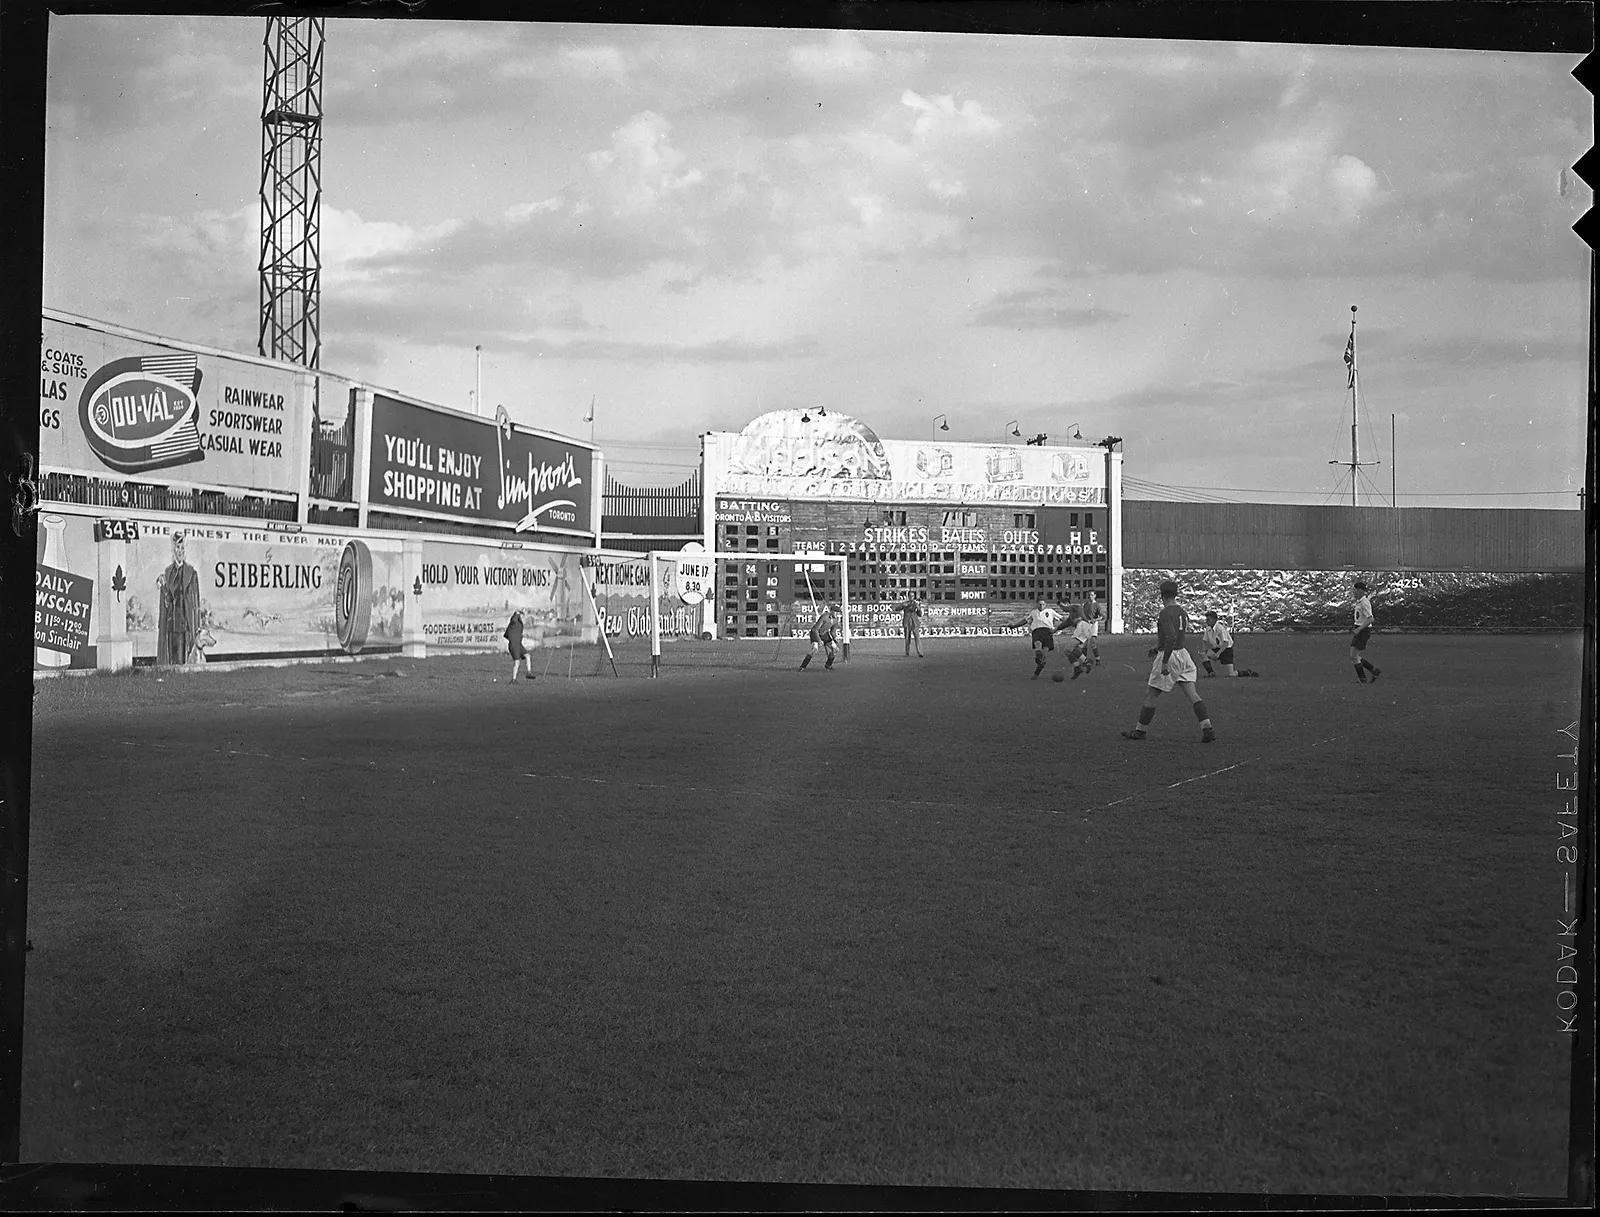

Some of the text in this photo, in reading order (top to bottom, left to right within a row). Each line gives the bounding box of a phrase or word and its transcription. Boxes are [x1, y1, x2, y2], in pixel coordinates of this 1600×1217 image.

[46, 349, 83, 366] COATS
[42, 360, 87, 379] & SUITS
[41, 379, 67, 401] LAS
[224, 387, 284, 411] RAINWEAR
[41, 409, 60, 430] GS
[210, 410, 283, 435] SPORTSWEAR
[200, 433, 282, 458] CASUAL WEAR
[385, 434, 481, 479] YOU'LL ENJOY
[498, 408, 582, 530] Simpson's
[383, 470, 483, 510] SHOPPING AT
[720, 501, 780, 511] BATTING
[548, 510, 576, 523] TORONTO
[762, 514, 792, 523] VISITORS
[143, 526, 344, 547] THE FINEST TIRE EVER MADE
[770, 527, 776, 536] 5
[864, 528, 1098, 546] STRIKES BALLS OUTS H E
[796, 541, 826, 551] TEAMS
[830, 543, 834, 552] 1
[839, 543, 845, 552] 2
[850, 543, 856, 552] 3
[860, 543, 866, 552] 4
[870, 543, 876, 552] 5
[880, 543, 886, 552] 6
[890, 543, 896, 552] 7
[900, 543, 907, 552] 8
[910, 543, 917, 552] 9
[959, 543, 987, 552] TEAMS
[1001, 545, 1007, 554] 2
[1010, 545, 1016, 554] 3
[1020, 545, 1026, 554] 4
[1029, 545, 1035, 554] 5
[1038, 545, 1044, 554] 6
[1047, 545, 1053, 554] 7
[1056, 545, 1063, 554] 8
[1065, 546, 1071, 554] 9
[1073, 546, 1082, 554] 10
[215, 562, 322, 589] SEIBERLING
[422, 564, 551, 587] HOLD YOUR VICTORY BONDS!
[596, 563, 651, 587] NEXT HOME GAM
[680, 564, 709, 578] JUNE 17
[961, 565, 986, 574] BALT
[767, 577, 778, 586] 10
[36, 590, 89, 619] WSCAST
[961, 591, 986, 600] MONT
[766, 604, 772, 612] 8
[867, 604, 892, 612] BOOK
[951, 608, 987, 617] NUMBERS
[423, 623, 466, 634] GOODERHAM
[467, 624, 473, 633] &
[473, 622, 494, 633] WORTS
[627, 606, 652, 636] Glob
[796, 615, 812, 623] THE
[873, 614, 902, 623] BOARD
[48, 630, 82, 650] Sinclair
